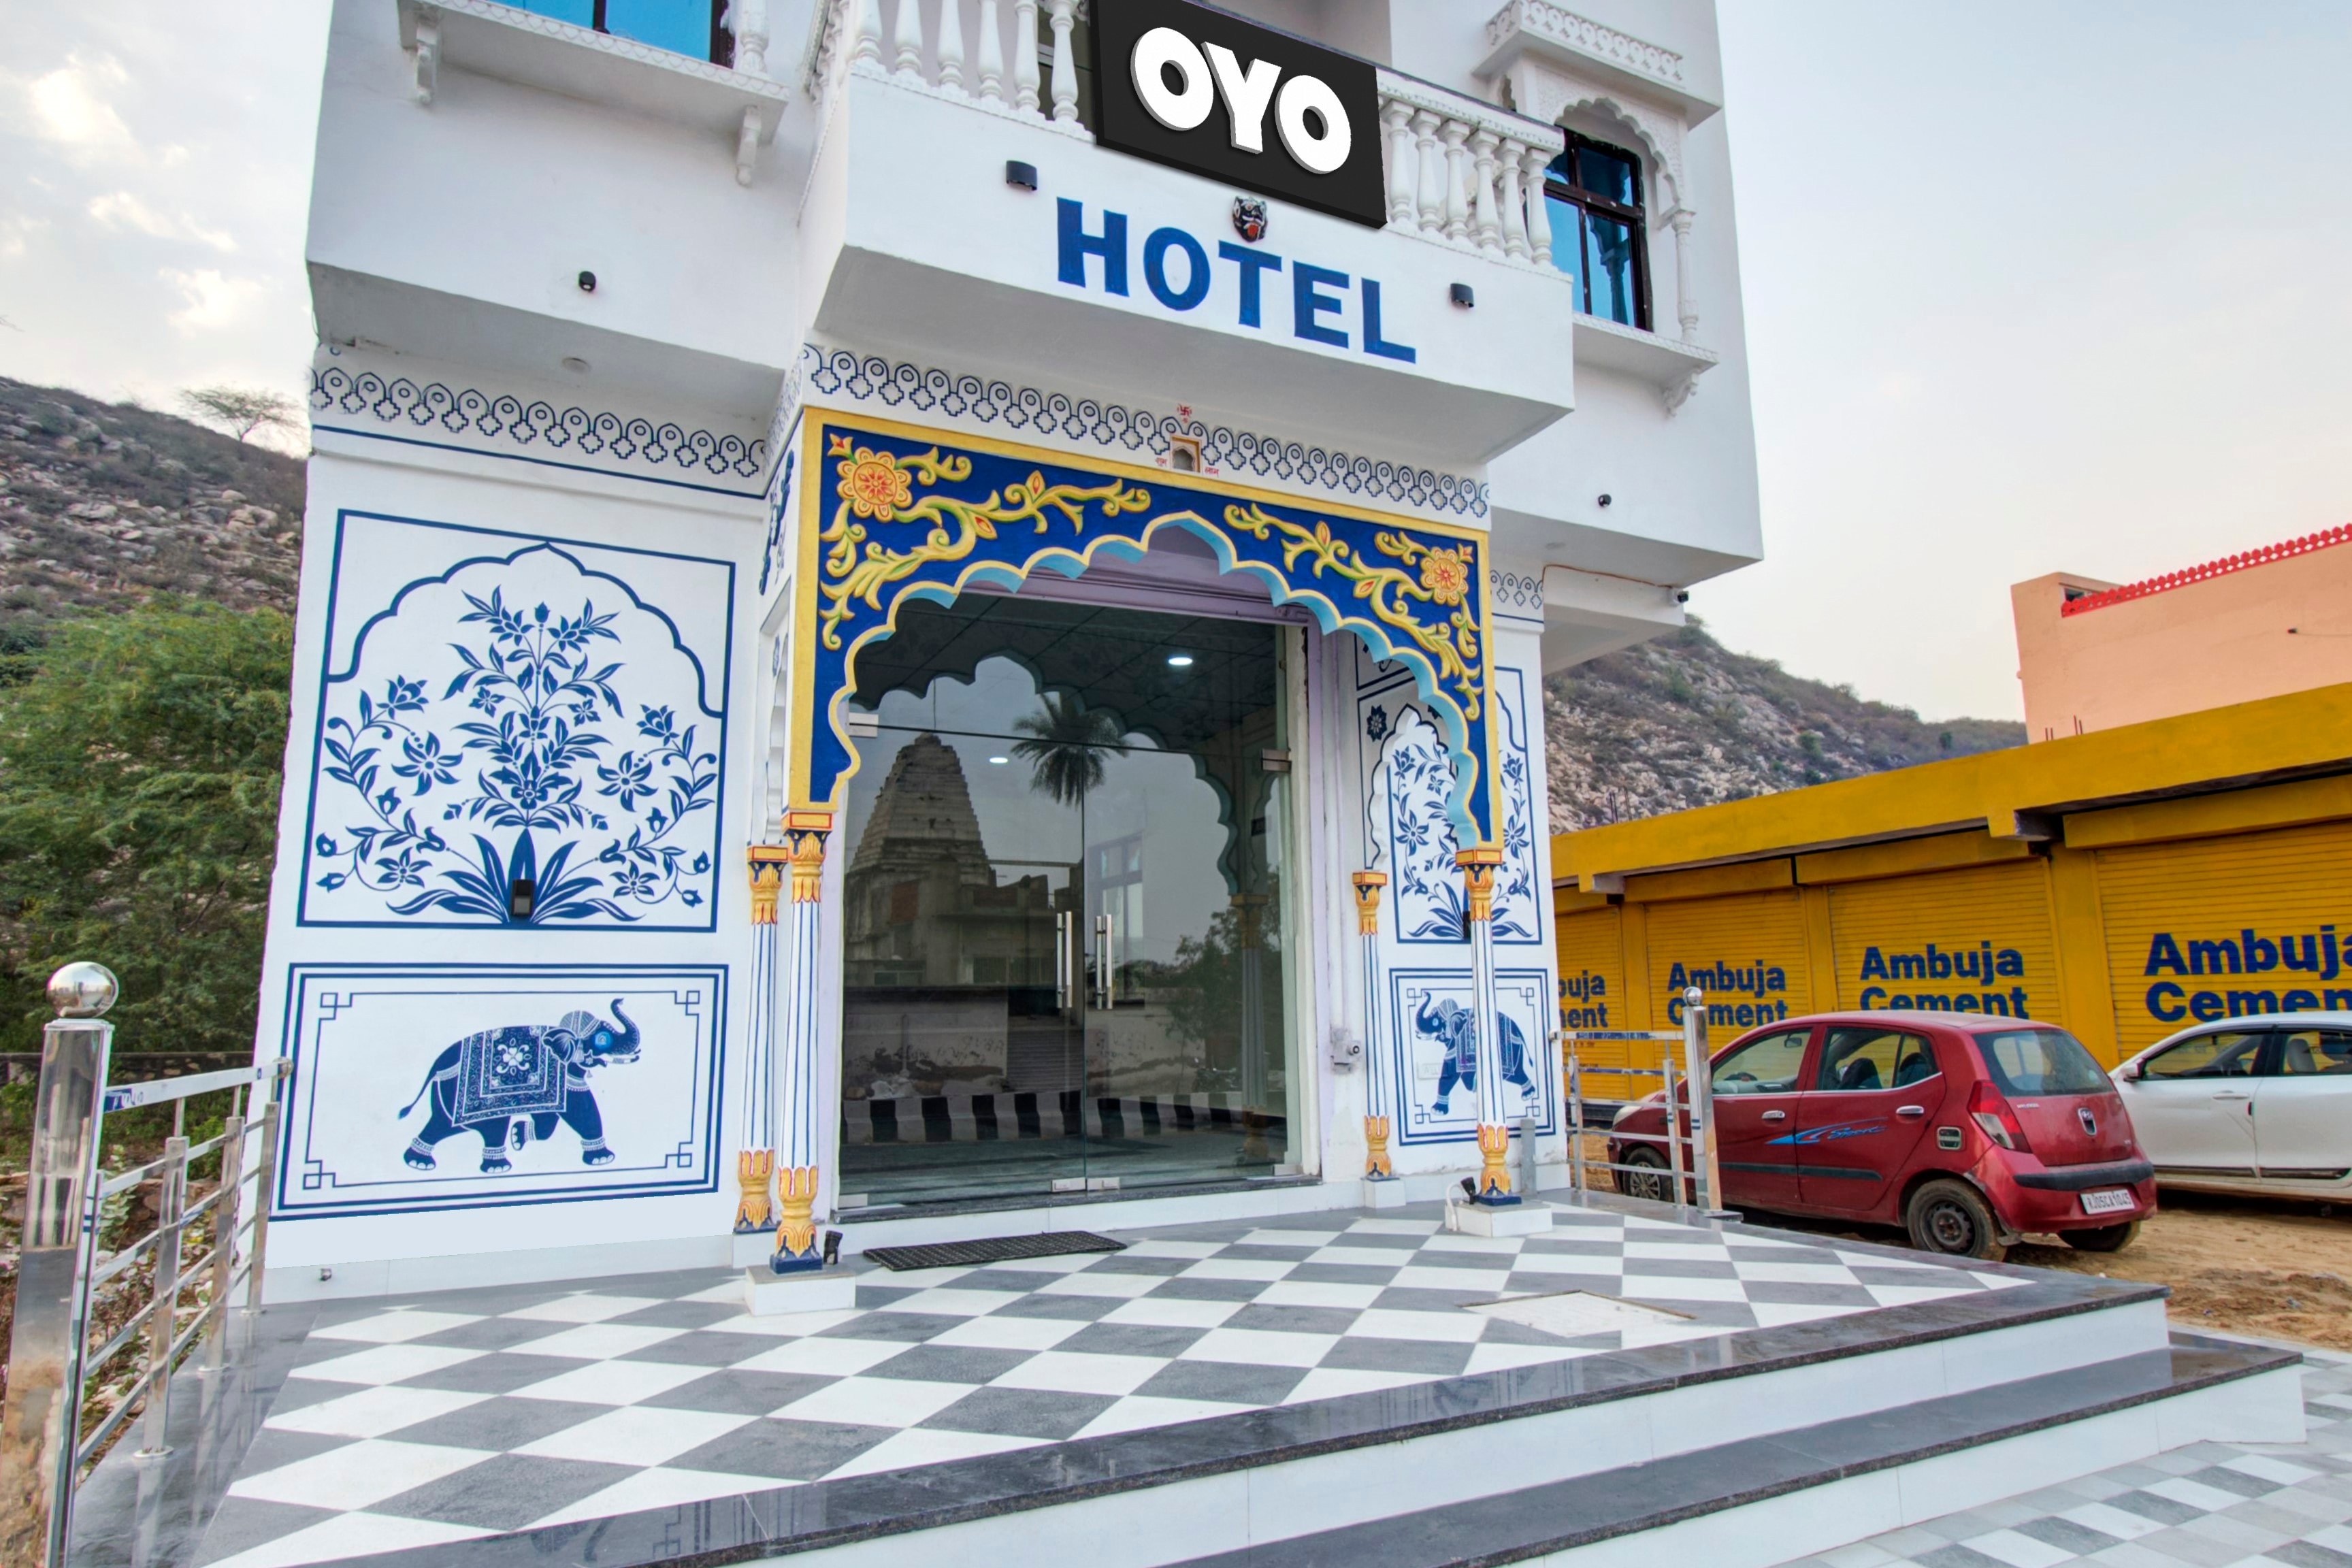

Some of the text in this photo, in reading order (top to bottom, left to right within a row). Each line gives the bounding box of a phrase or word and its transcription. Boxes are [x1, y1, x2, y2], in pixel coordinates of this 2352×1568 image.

[1130, 27, 1352, 174] OYO
[1056, 197, 1416, 364] HOTEL
[1859, 940, 2025, 986] Ambuja
[2144, 925, 2352, 981] Ambuj
[1667, 960, 1786, 998] Ambuja
[1667, 993, 1788, 1027] Cment
[1859, 986, 2029, 1020] Cement
